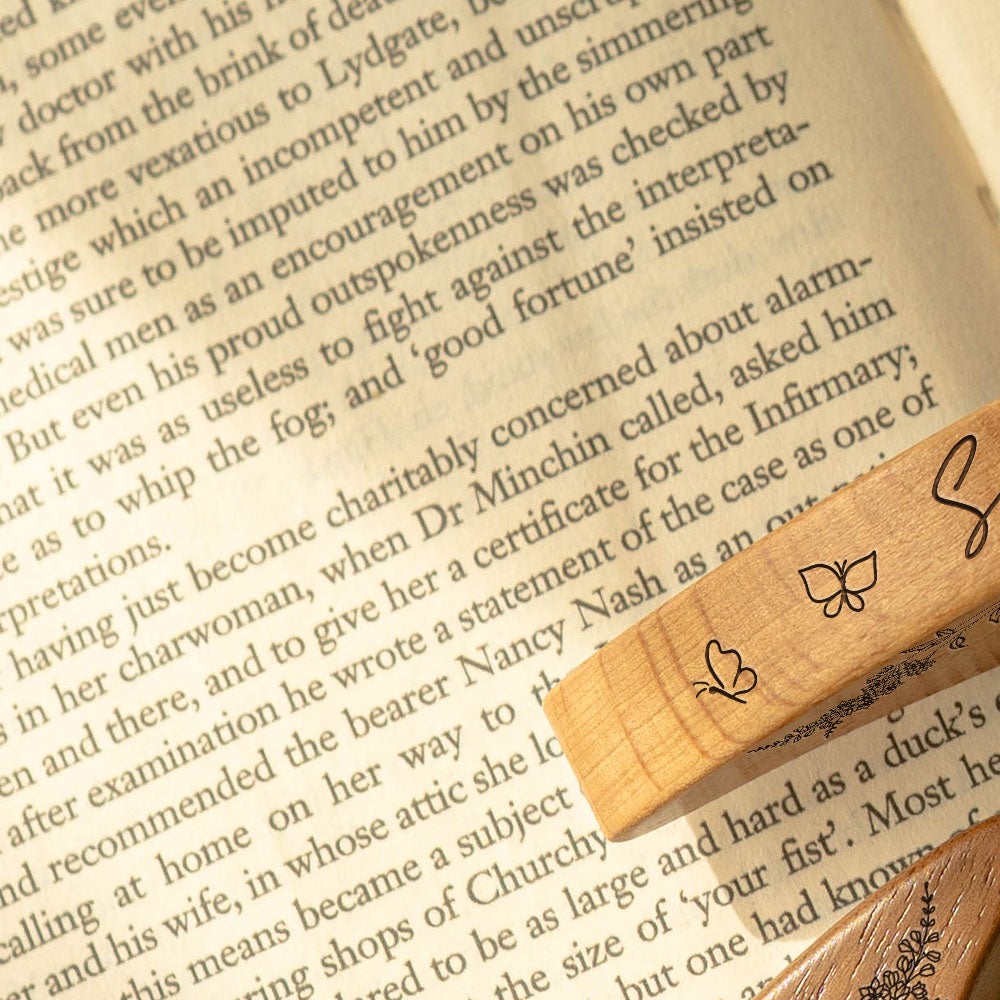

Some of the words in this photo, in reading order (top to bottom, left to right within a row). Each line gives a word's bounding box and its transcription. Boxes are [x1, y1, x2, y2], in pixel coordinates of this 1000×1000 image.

[24, 21, 106, 79] some
[57, 114, 139, 168] from
[140, 85, 195, 126] the
[192, 33, 285, 98] brink
[287, 6, 322, 51] of
[103, 312, 177, 361] men
[183, 291, 217, 324] as
[223, 270, 265, 304] an
[270, 142, 514, 280] encouragement
[518, 121, 564, 155] on
[562, 90, 617, 133] his
[623, 57, 697, 104] own
[701, 24, 774, 80] part
[6, 613, 119, 681] having
[121, 580, 183, 636] just
[184, 519, 317, 592] become
[325, 434, 479, 528] charitably
[489, 340, 657, 448] concerned
[663, 301, 760, 365] about
[764, 255, 873, 315] alarm-
[30, 533, 62, 561] as
[70, 509, 106, 538] to
[115, 463, 196, 515] whip
[205, 434, 261, 473] the
[269, 399, 336, 444] fog;
[343, 352, 406, 410] and
[409, 301, 506, 379] ‘good
[512, 235, 635, 324] fortune’
[648, 171, 778, 257] insisted
[787, 159, 835, 193] on
[41, 722, 102, 778] and
[104, 689, 200, 744] there,
[203, 641, 266, 697] and
[269, 635, 306, 665] to
[312, 599, 380, 657] give
[379, 569, 439, 612] her
[446, 558, 468, 583] a
[472, 478, 630, 569] certificate
[633, 450, 683, 491] for
[687, 423, 744, 463] the
[742, 343, 918, 436] Infirmary;
[43, 940, 107, 997] and
[104, 923, 158, 966] his
[160, 885, 243, 938] wife,
[242, 868, 282, 901] in
[282, 817, 390, 878] whose
[394, 778, 468, 830] attic
[472, 752, 528, 795] she
[429, 952, 467, 982] to
[468, 927, 517, 962] be
[525, 906, 560, 940] as
[560, 865, 649, 920] large
[656, 819, 722, 877] and
[720, 779, 806, 845] hard
[810, 770, 846, 804] as
[852, 758, 876, 784] a
[882, 700, 987, 768] duck’s
[685, 933, 749, 976] one
[749, 887, 821, 946] had
